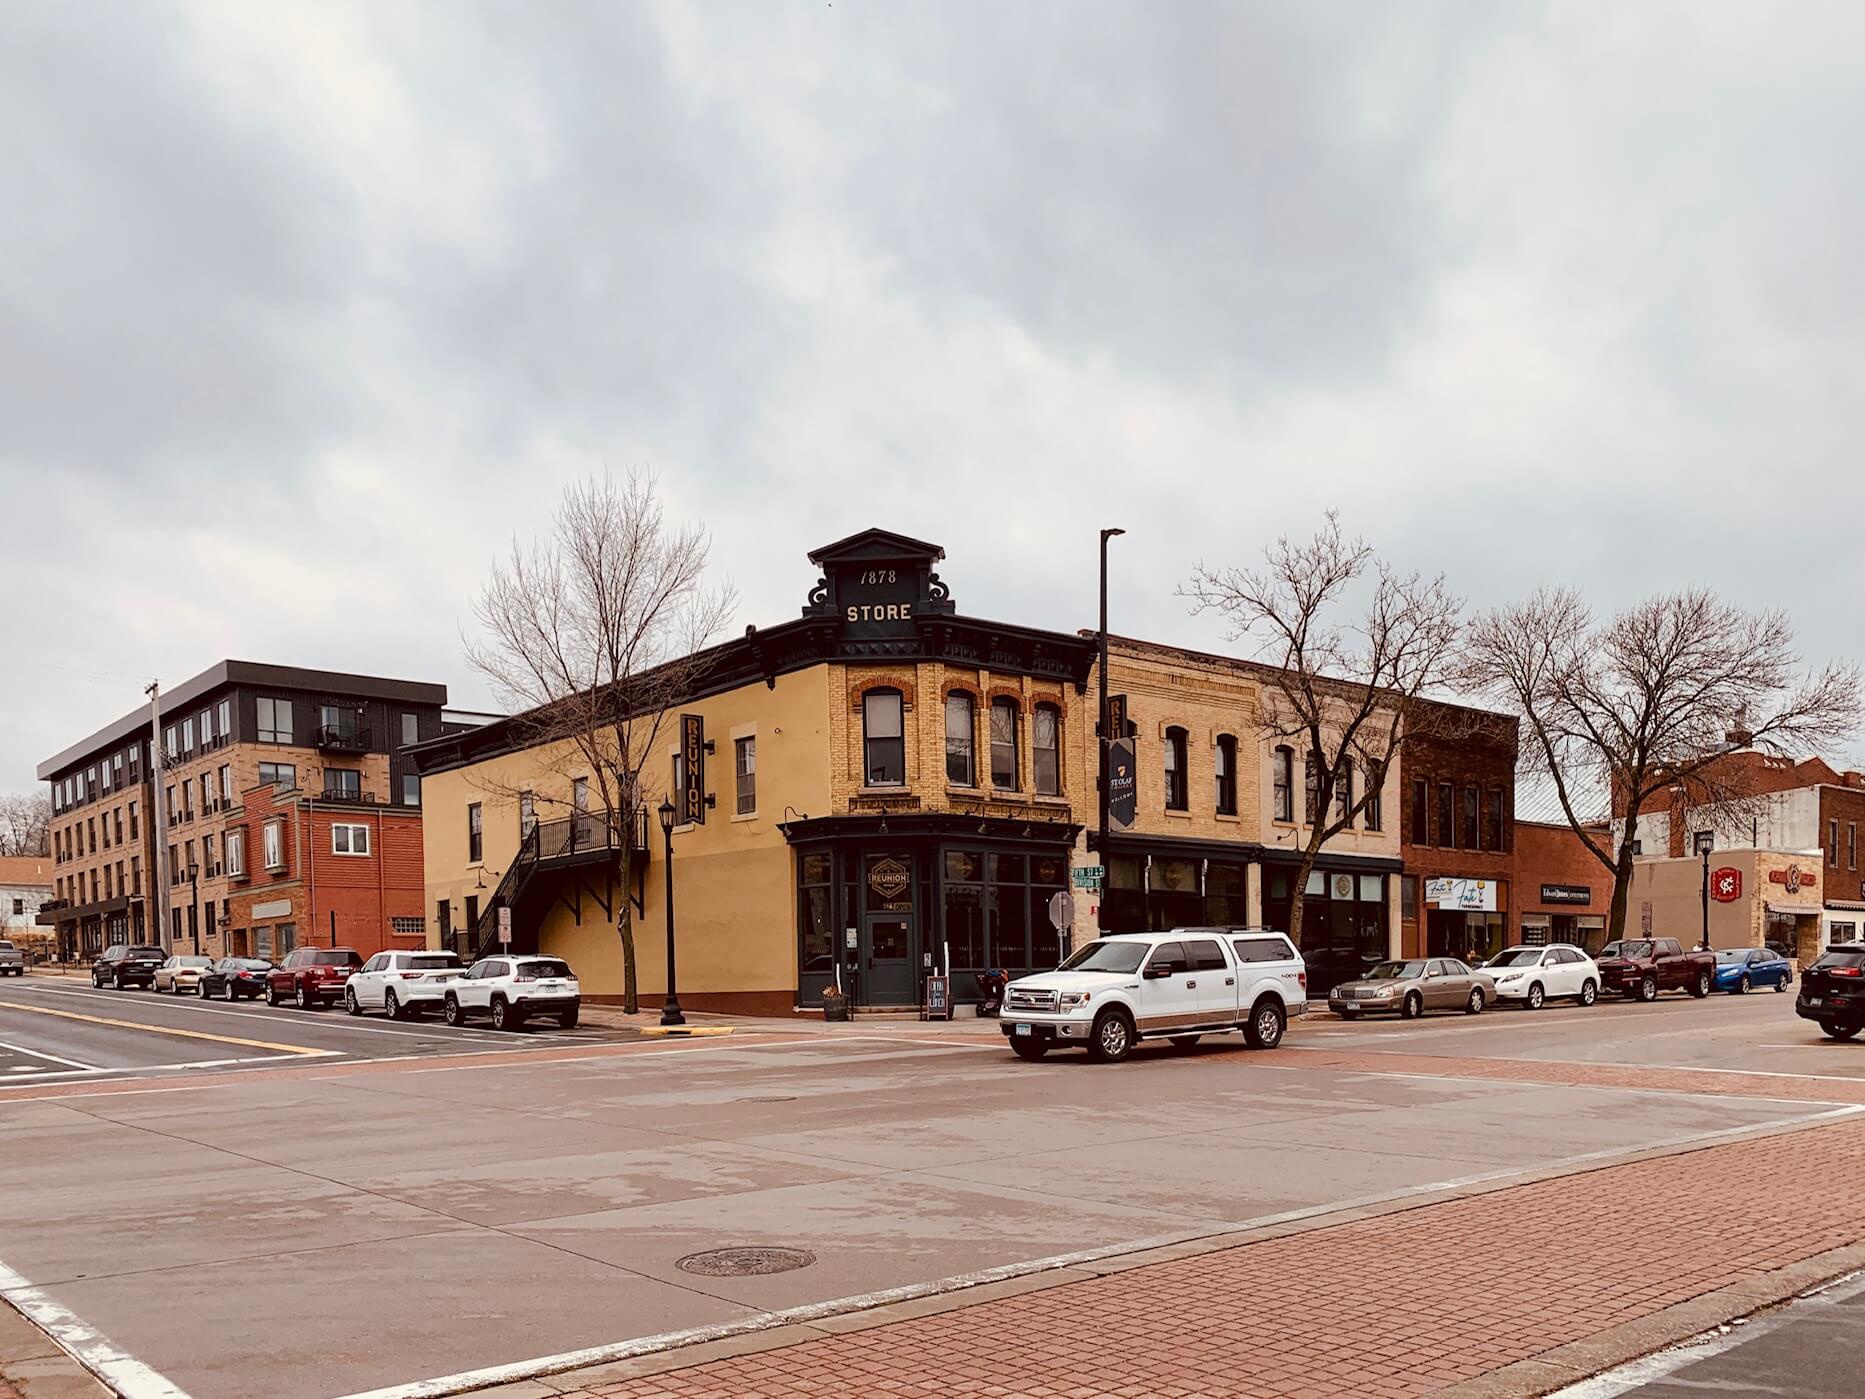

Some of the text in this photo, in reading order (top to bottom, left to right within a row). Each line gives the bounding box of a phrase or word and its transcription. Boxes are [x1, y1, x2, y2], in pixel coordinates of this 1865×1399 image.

[860, 569, 896, 585] 1878
[847, 603, 912, 622] STORE
[687, 718, 699, 817] REUNION
[871, 874, 907, 882] REUNION
